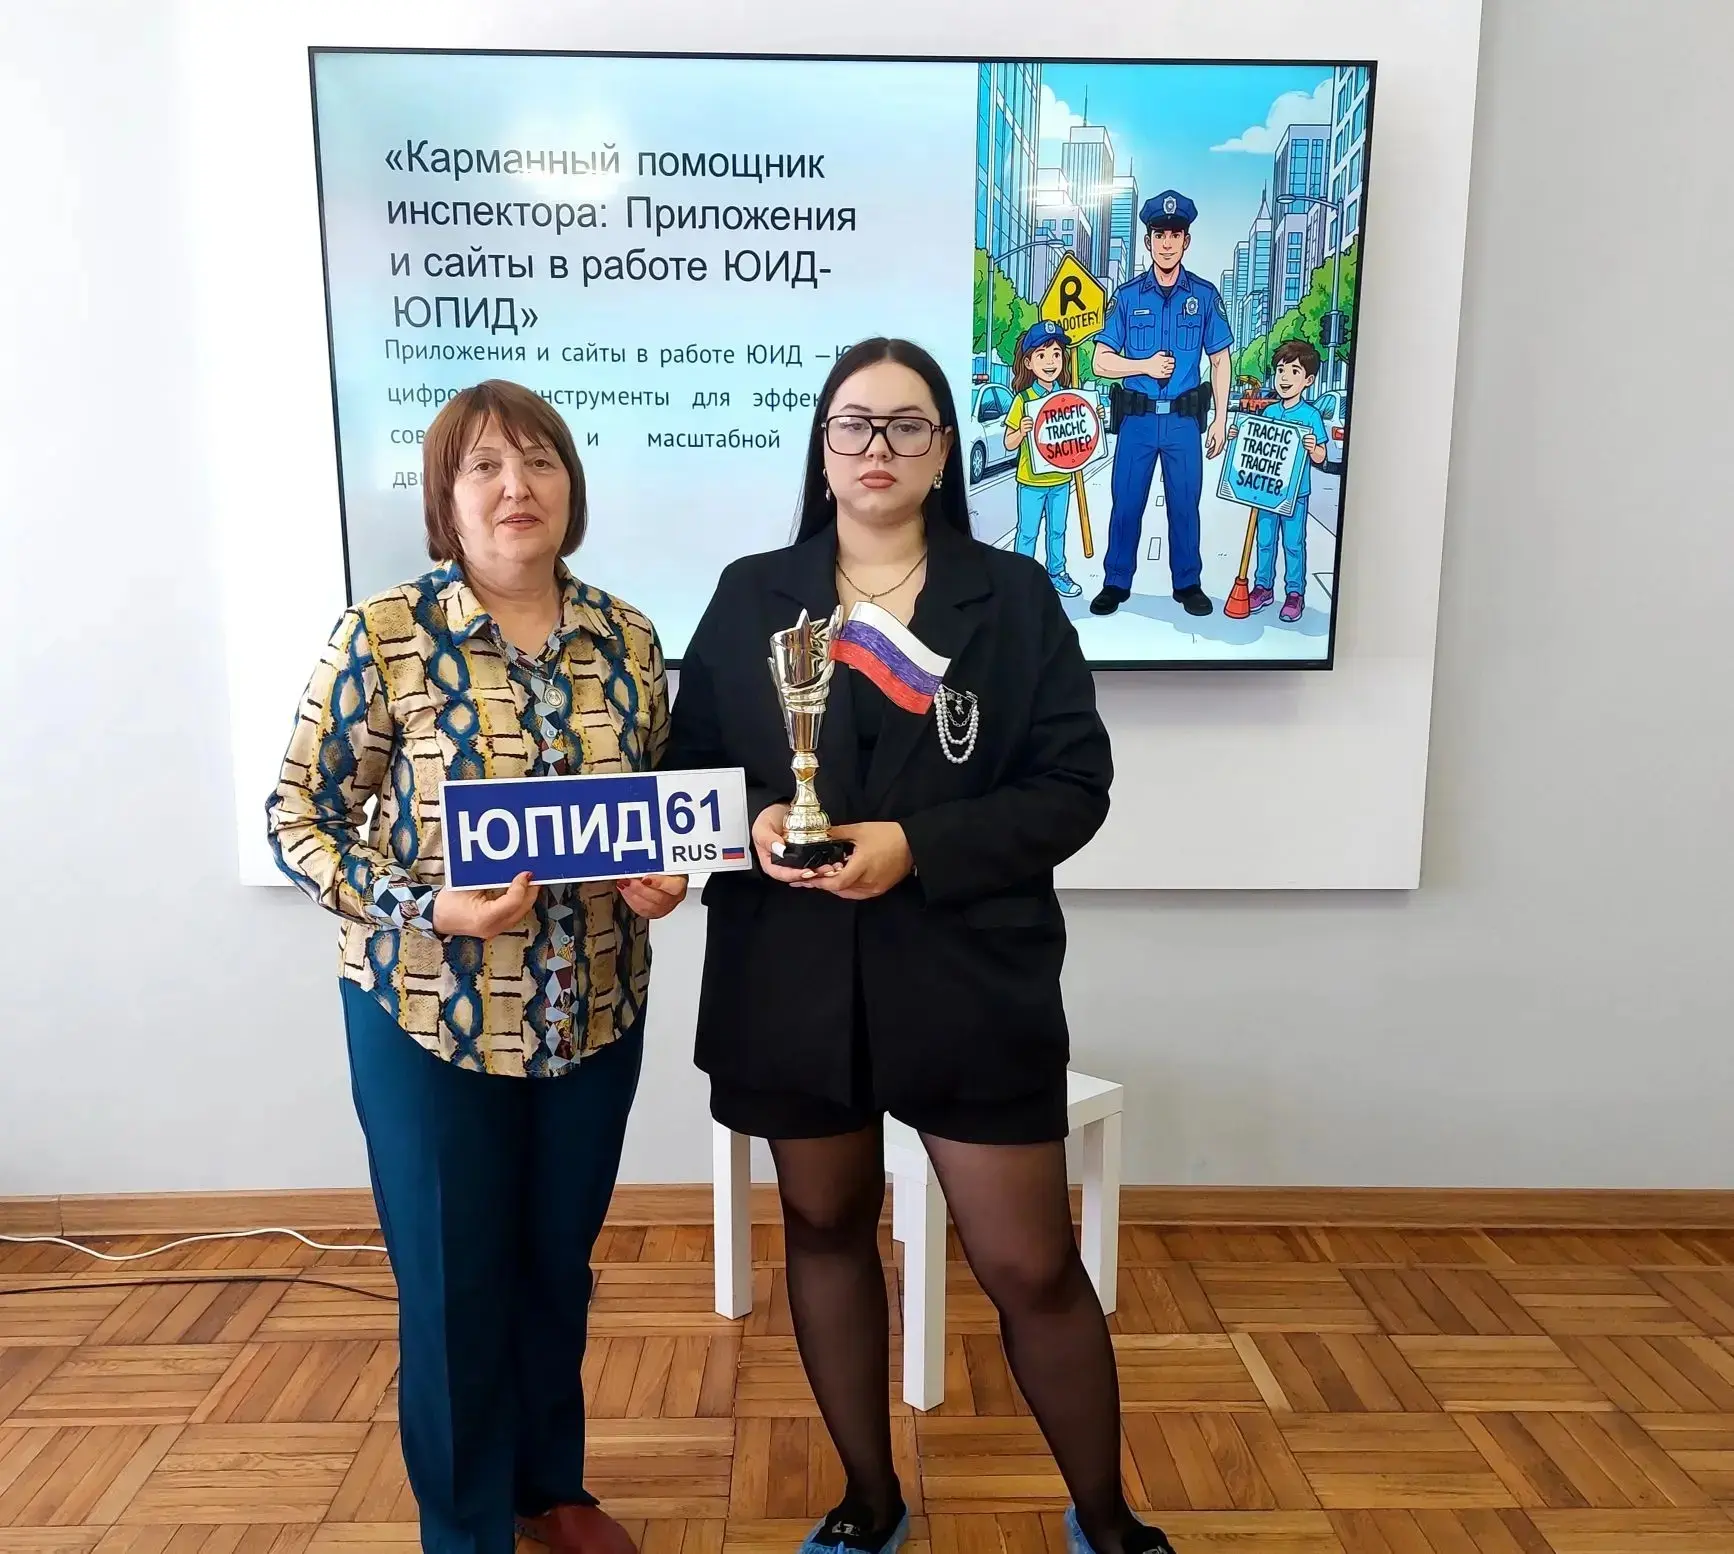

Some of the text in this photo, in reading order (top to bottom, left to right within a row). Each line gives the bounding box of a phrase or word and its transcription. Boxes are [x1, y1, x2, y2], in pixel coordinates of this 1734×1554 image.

[385, 140, 826, 184] «Карманный помощник
[388, 196, 856, 237] инспектора: Приложения
[390, 246, 832, 289] и сайты в работе ЮИД-
[394, 295, 539, 336] ЮПИД»
[1060, 276, 1086, 316] R
[385, 339, 526, 364] Приложения
[537, 346, 549, 362] и
[562, 342, 626, 363] сайты
[637, 347, 649, 363] в
[661, 343, 735, 366] работе
[747, 344, 803, 368] ЮИД
[536, 388, 670, 411] нструменты
[692, 391, 730, 410] для
[586, 428, 780, 449] и масштабной
[458, 789, 721, 862] ЮПИД 61
[672, 843, 717, 863] RUS
